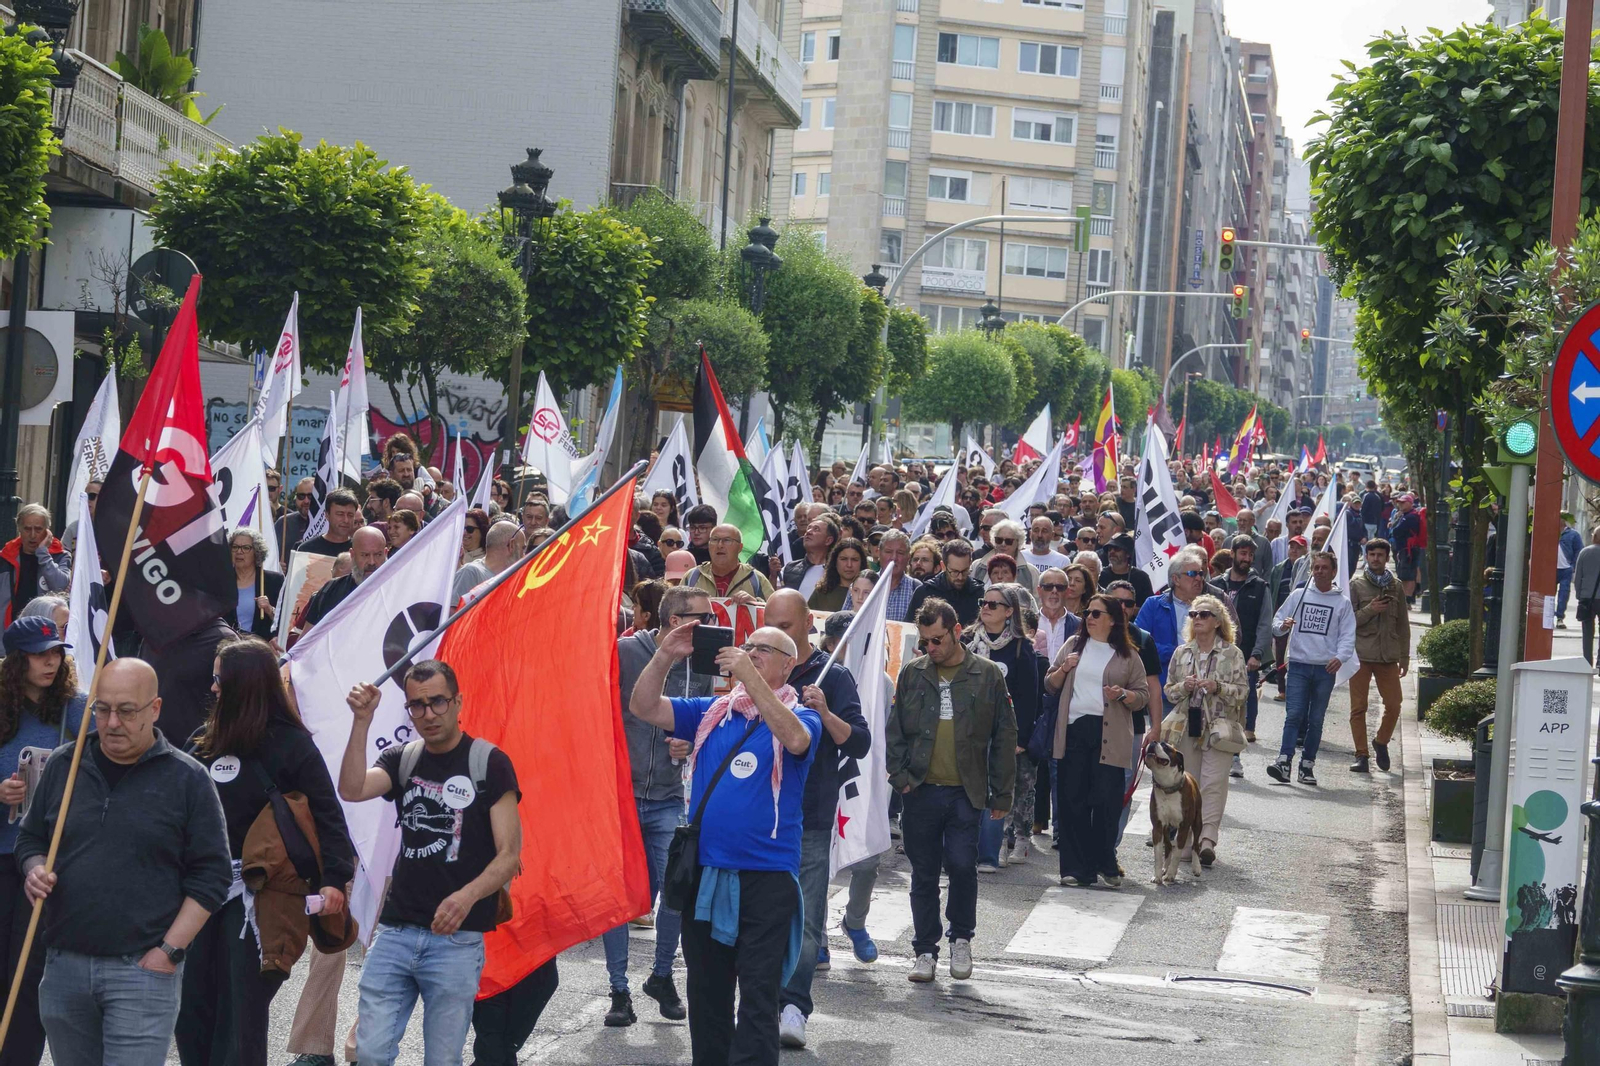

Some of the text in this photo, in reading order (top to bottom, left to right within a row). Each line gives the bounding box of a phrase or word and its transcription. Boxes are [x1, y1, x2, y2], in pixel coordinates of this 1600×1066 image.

[213, 412, 229, 423] NO
[131, 525, 182, 605] VIGO
[1305, 606, 1329, 617] LUME
[1304, 614, 1327, 624] LUME
[1302, 621, 1326, 631] LUME
[1538, 722, 1571, 735] APP
[404, 838, 447, 859] DE FUTURO
